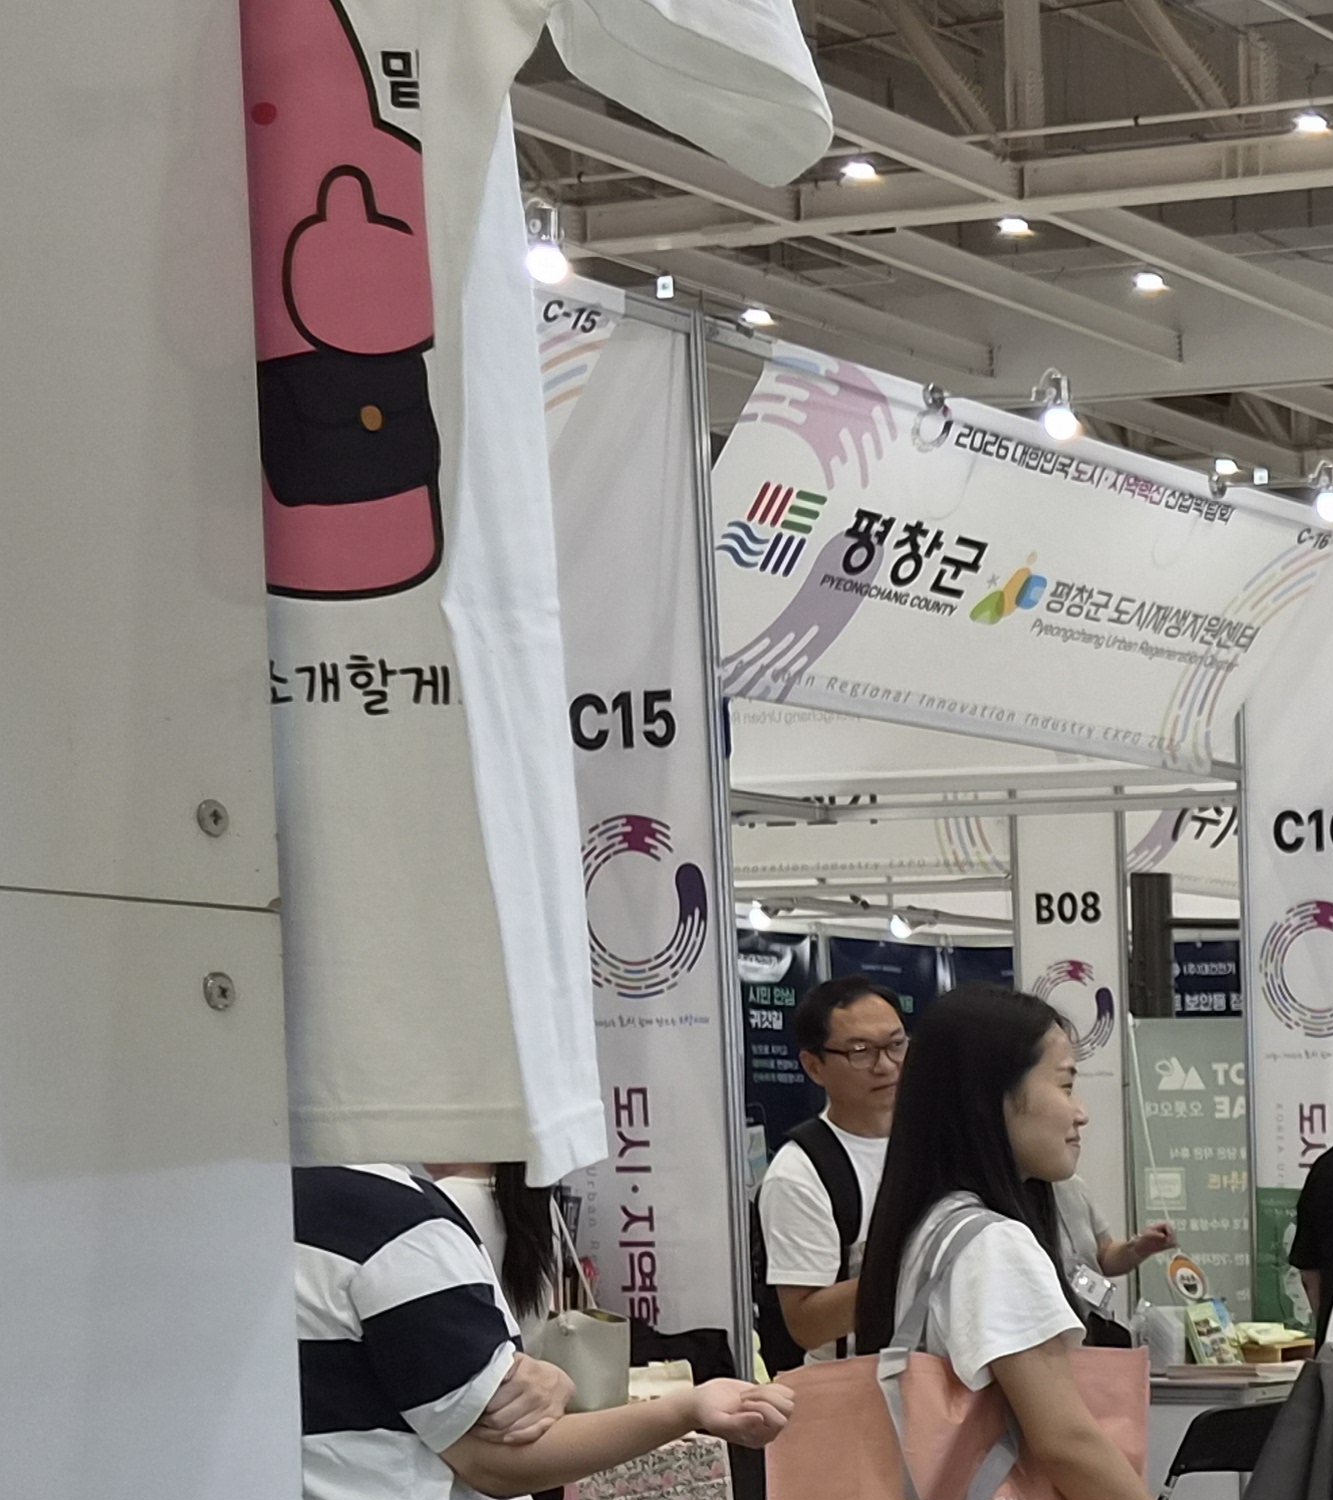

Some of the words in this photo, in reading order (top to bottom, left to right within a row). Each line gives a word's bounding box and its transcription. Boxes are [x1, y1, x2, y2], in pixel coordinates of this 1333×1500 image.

[542, 299, 601, 335] C-15
[954, 423, 1010, 460] 2026
[1010, 442, 1073, 480] 대한민국
[1164, 489, 1236, 525] 산업박람회
[842, 508, 989, 599] 평창군
[1297, 527, 1332, 550] C-16
[820, 574, 909, 605] PYEONGCHANG
[909, 596, 957, 617] COUNTY
[1045, 580, 1113, 623] 평창군
[1107, 596, 1261, 653] 도시재생지원센터
[1030, 618, 1105, 650] Pyeongchang
[1105, 635, 1139, 652] Urban
[568, 689, 677, 752] C15
[826, 677, 909, 704] Regional
[919, 693, 1016, 723] Innovation
[1024, 713, 1094, 740] Industry
[1103, 727, 1142, 745] EXPO
[1034, 890, 1102, 925] B08
